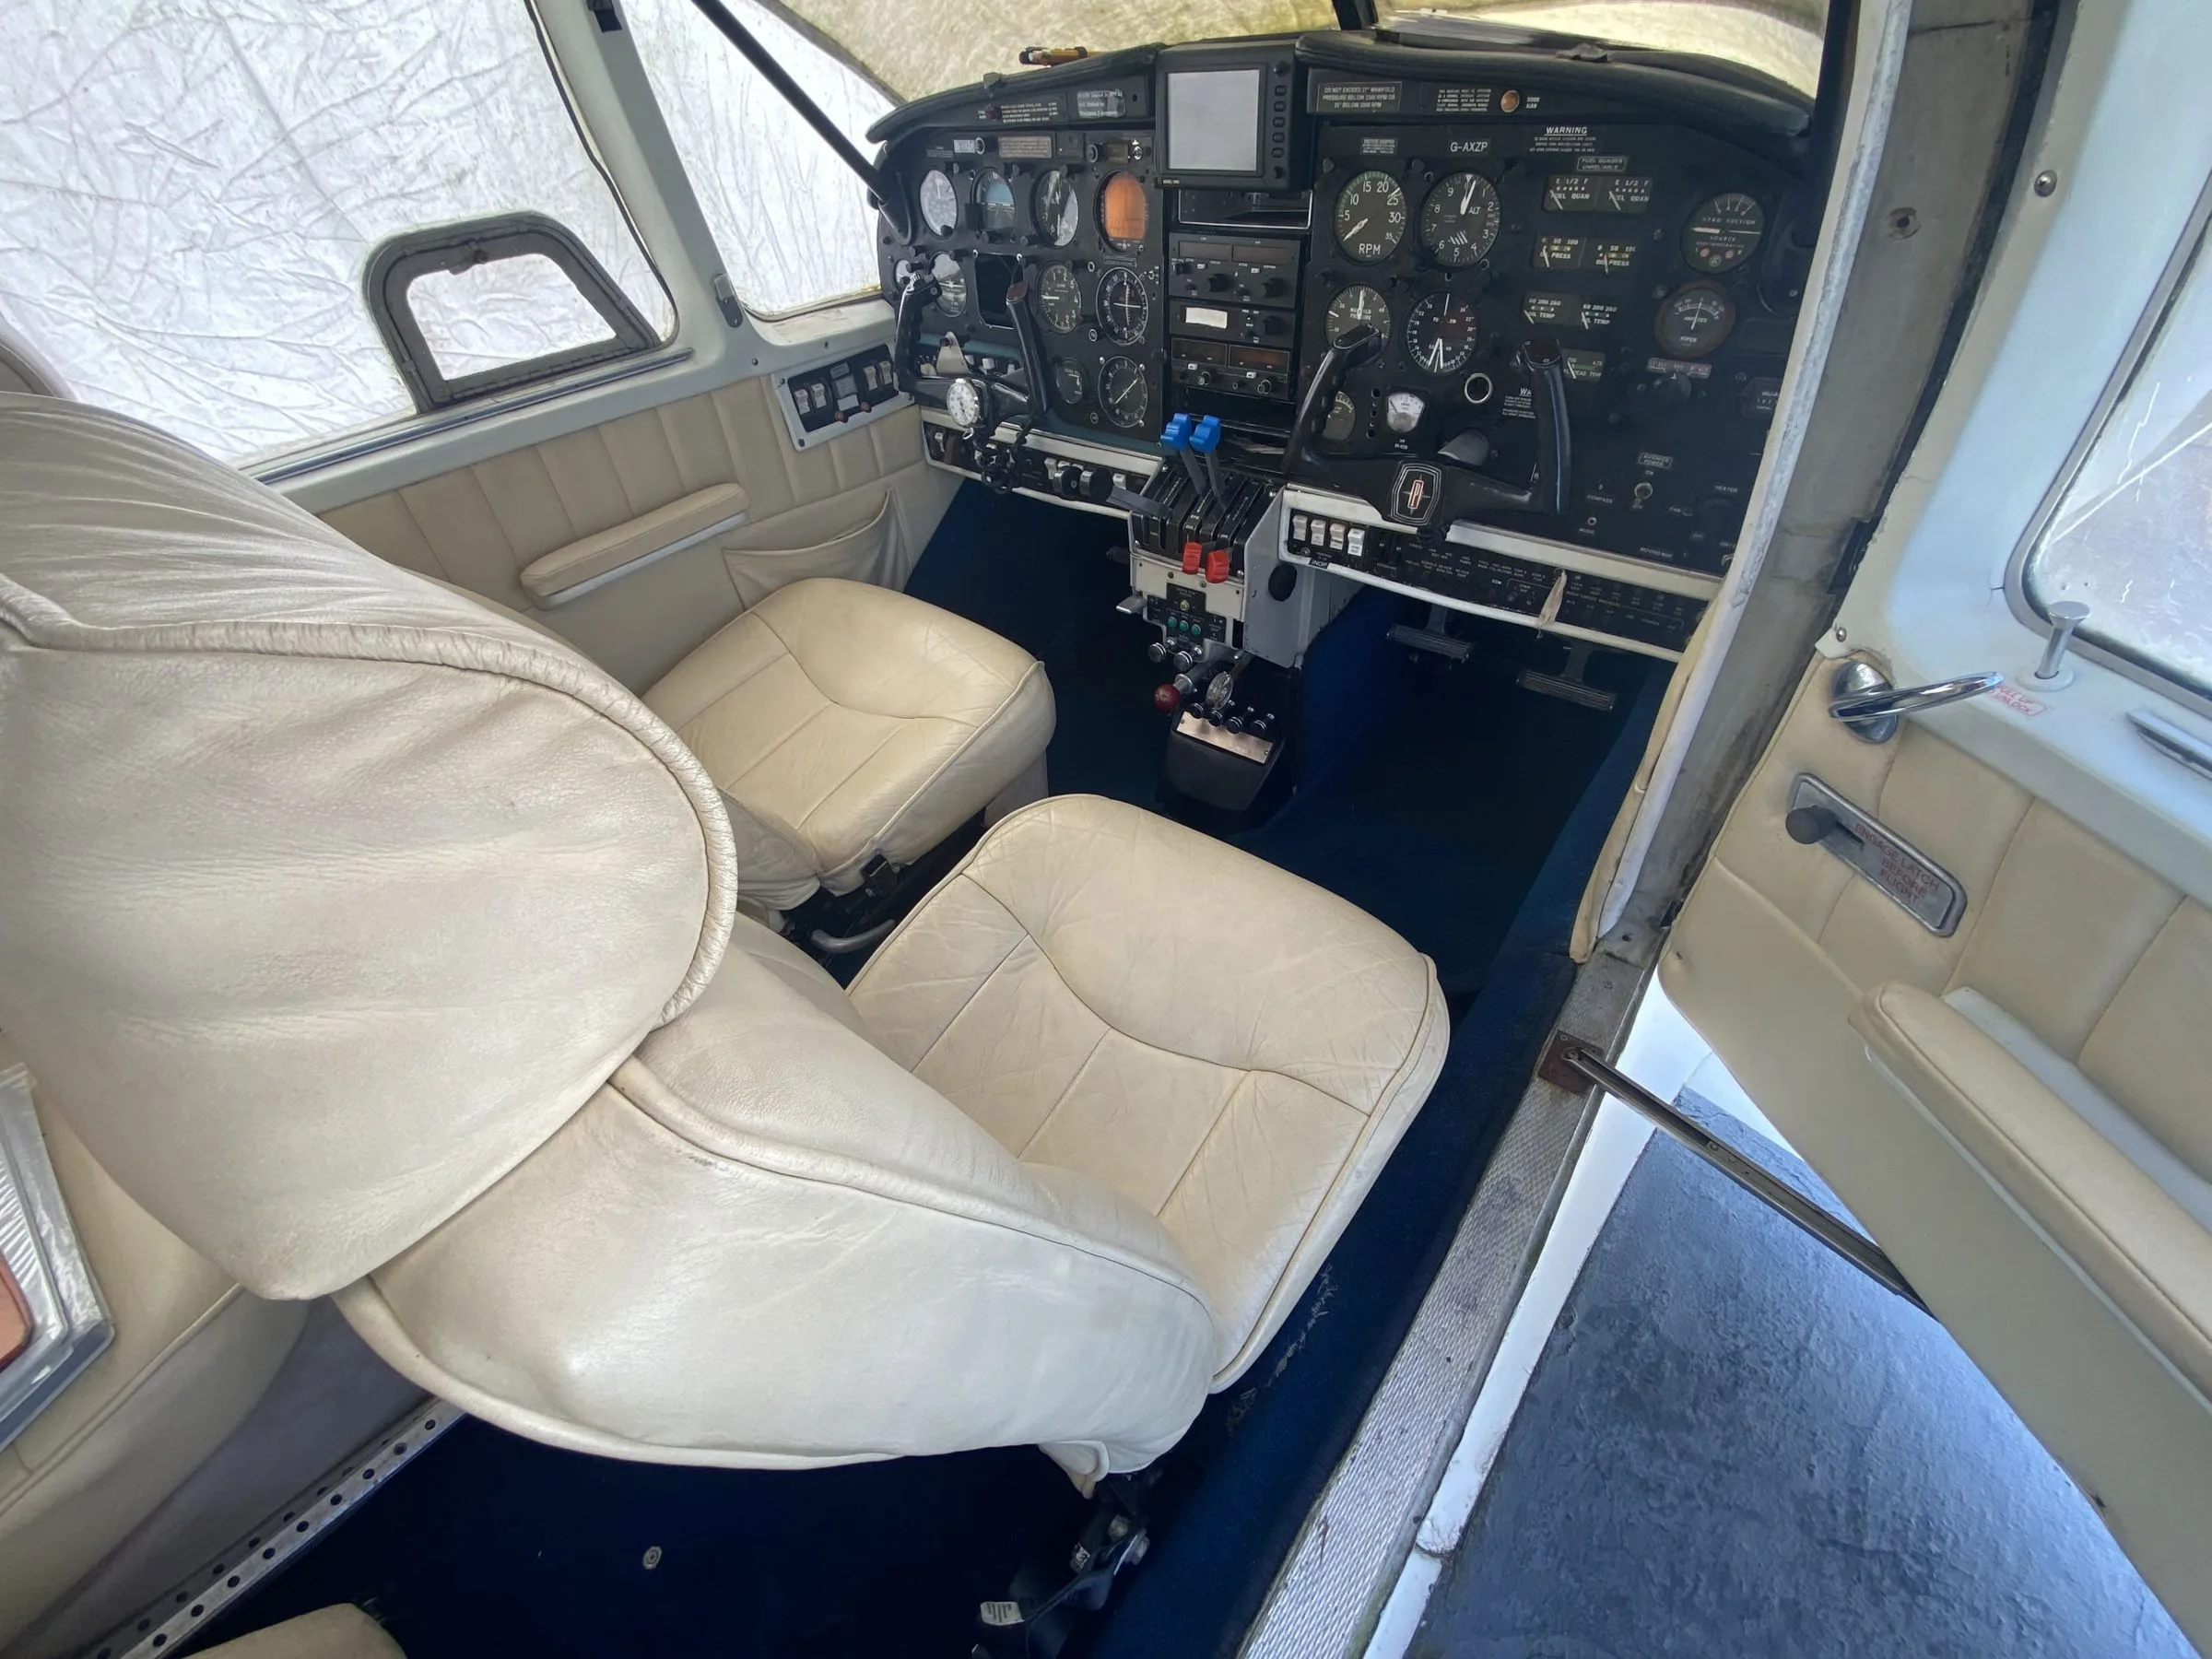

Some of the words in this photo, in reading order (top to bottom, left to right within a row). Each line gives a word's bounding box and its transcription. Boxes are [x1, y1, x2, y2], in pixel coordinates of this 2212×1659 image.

[1546, 126, 1587, 134] WARNING
[1450, 141, 1488, 152] G-AXZP
[1363, 181, 1372, 192] 15
[1377, 181, 1389, 193] 20
[1447, 187, 1454, 197] 9
[1350, 194, 1359, 205] 10
[1387, 194, 1399, 206] 25
[1434, 204, 1441, 213] 8
[1468, 206, 1480, 214] ALT
[1487, 202, 1494, 211] 2
[1344, 210, 1350, 220] 5
[1388, 212, 1401, 223] 30
[1431, 223, 1437, 232] 7
[1483, 229, 1488, 239] 3
[1358, 243, 1381, 254] RPM
[1439, 240, 1445, 249] 6
[1471, 243, 1477, 252] 4
[1454, 248, 1459, 257] 5
[1855, 824, 1899, 862] ENGAGE
[1902, 858, 1940, 892] LATCH
[1881, 858, 1927, 898] BEFORE
[1881, 870, 1920, 903] FLIGHT
